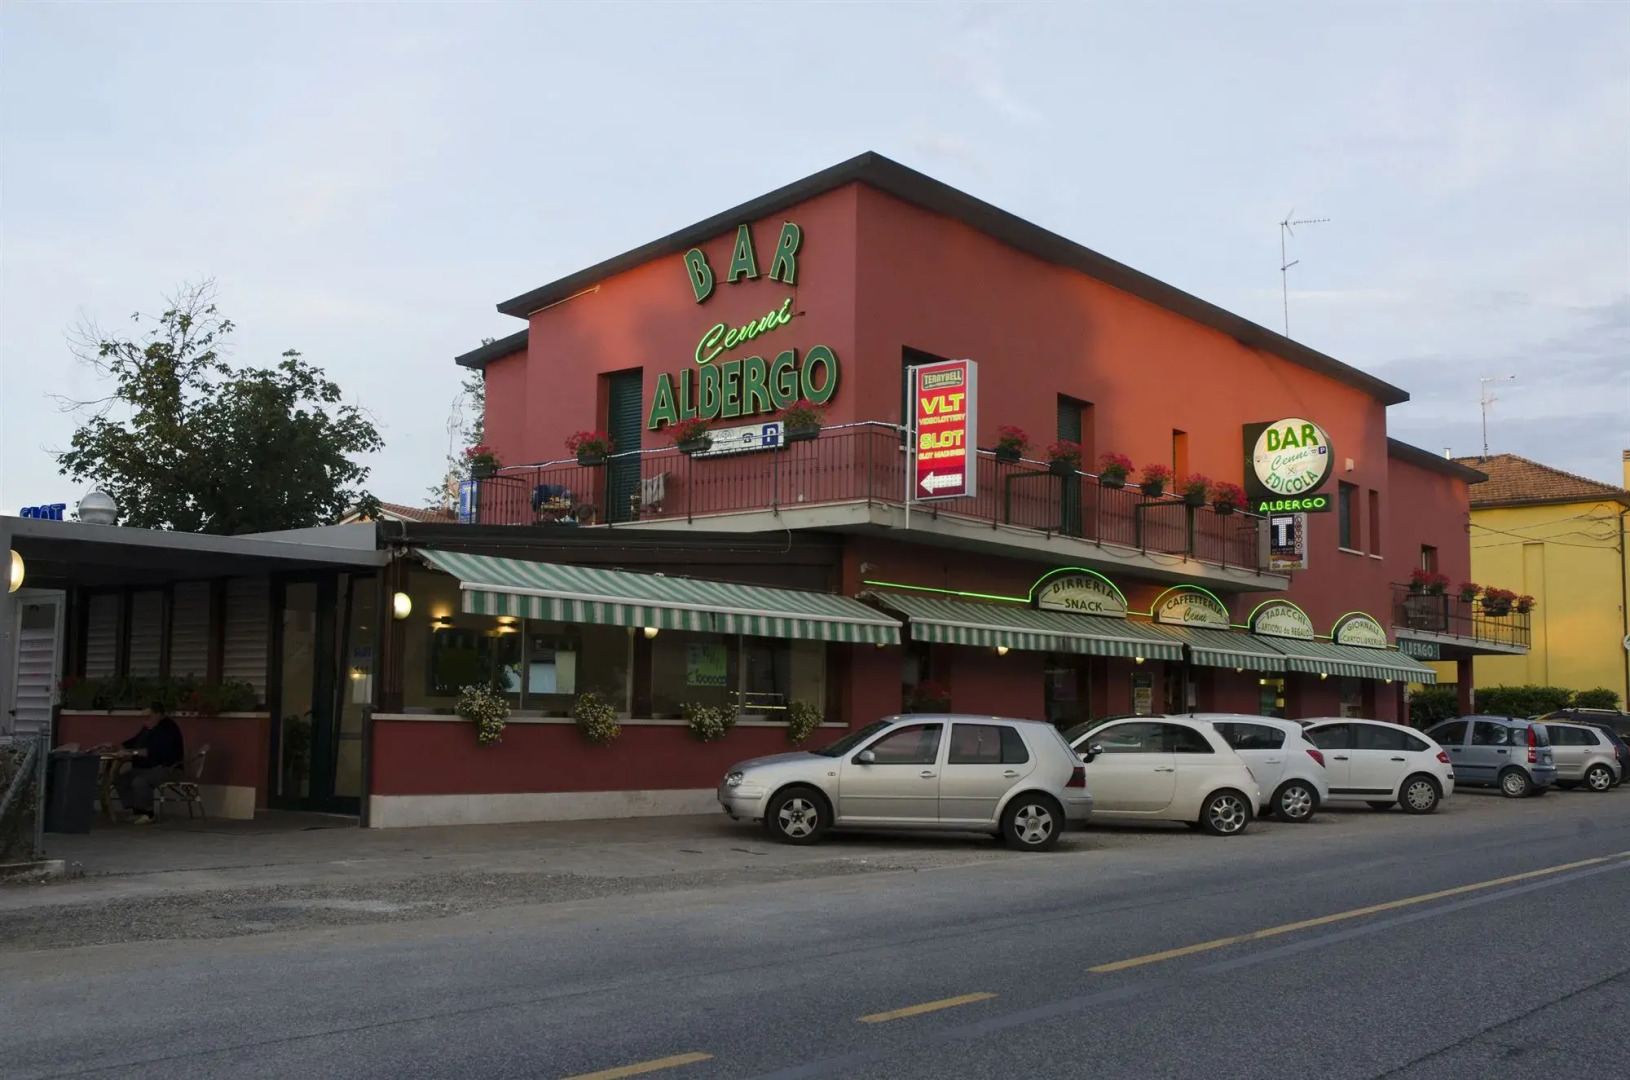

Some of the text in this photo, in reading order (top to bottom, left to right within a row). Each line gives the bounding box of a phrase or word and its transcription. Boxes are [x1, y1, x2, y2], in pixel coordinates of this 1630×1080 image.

[684, 221, 800, 304] BAR
[695, 298, 792, 364] Cenni
[647, 345, 838, 430] ALBERGO
[923, 370, 962, 385] TERRYBELL
[921, 393, 964, 415] VLT
[920, 430, 964, 450] SLOT
[1266, 423, 1319, 452] BAR
[1271, 449, 1310, 471] Cenni
[1265, 470, 1318, 493] EDICOLA
[1259, 497, 1326, 511] ALBERGO
[1272, 517, 1293, 546] T
[1052, 578, 1115, 601] BIRRERIA
[1065, 598, 1103, 612] SNACK
[1166, 594, 1223, 618] CAFFETTERIA
[1265, 608, 1306, 625] TABACCHI
[1346, 620, 1379, 635] GIORNALI
[1400, 641, 1433, 657] ALBERGO
